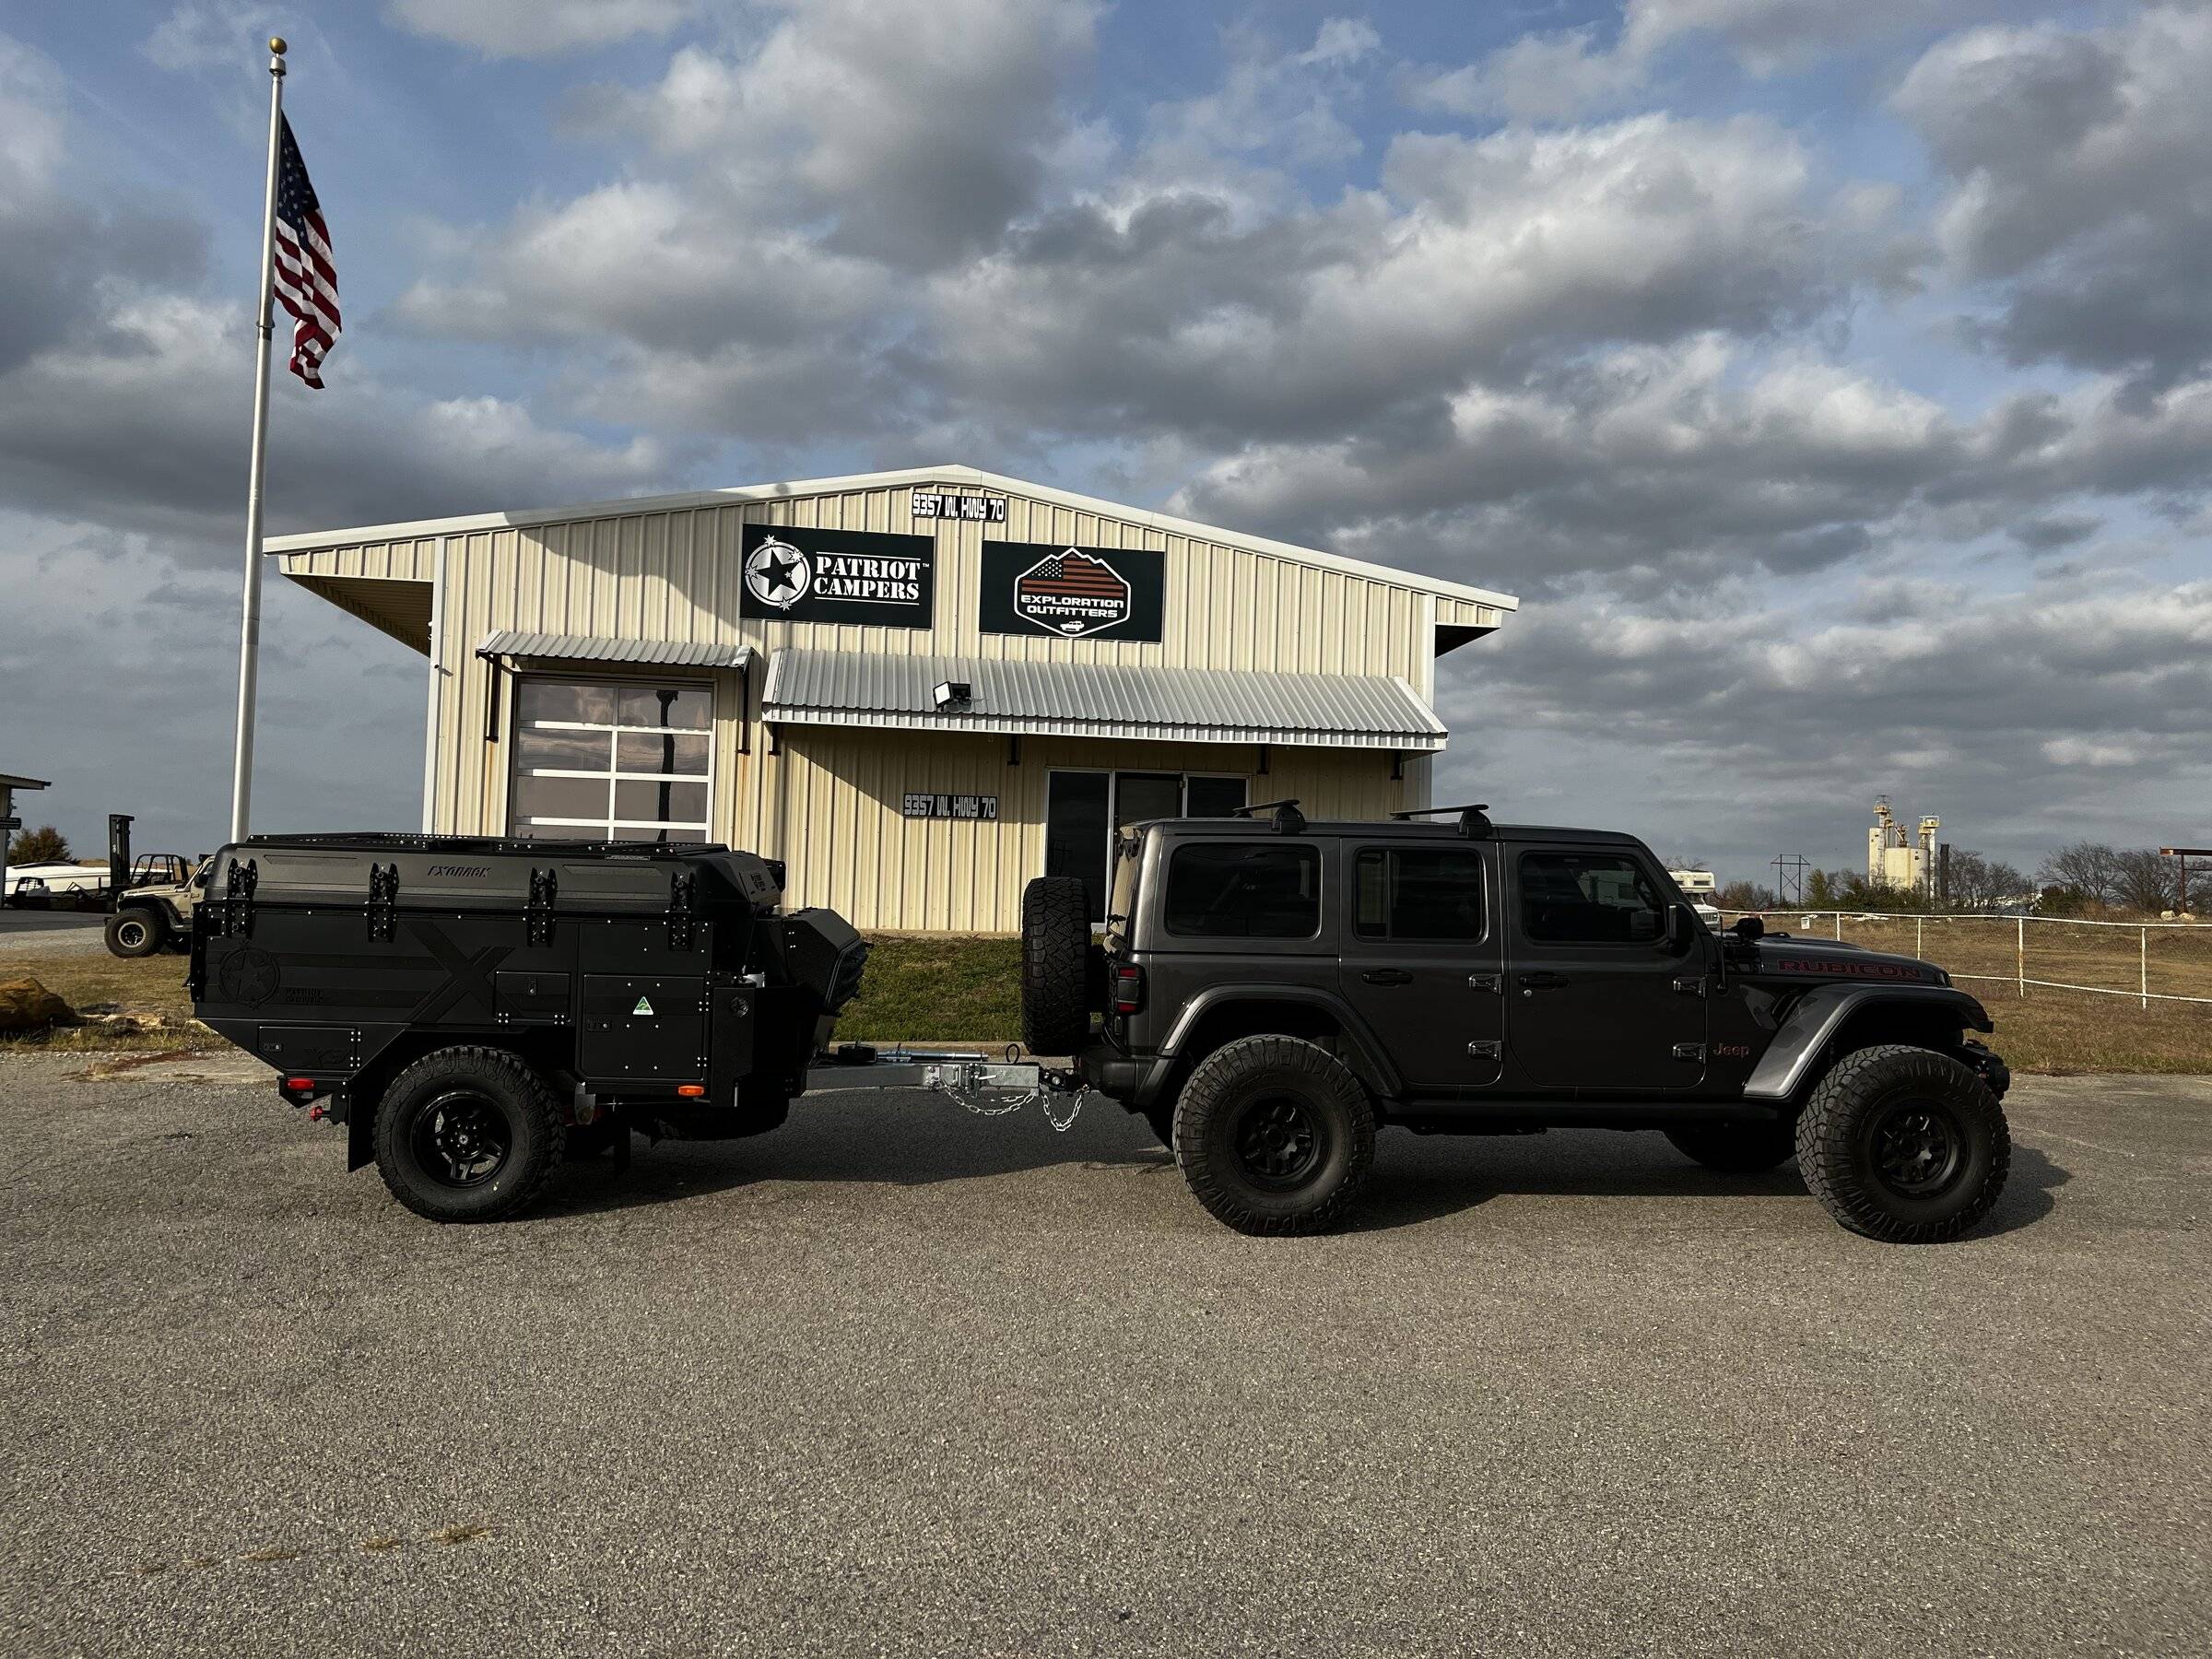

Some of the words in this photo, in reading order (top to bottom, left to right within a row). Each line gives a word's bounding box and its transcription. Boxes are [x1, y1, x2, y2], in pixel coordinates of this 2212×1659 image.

[912, 493, 942, 516] 9357
[945, 495, 959, 518] W.
[960, 497, 987, 519] HWY
[990, 499, 1005, 521] 70
[816, 556, 921, 580] PATRIOT
[813, 577, 920, 600] CAMPERS
[1020, 594, 1124, 607] EXPLORATION
[1026, 605, 1118, 618] OUTFITTERS
[904, 794, 934, 816] 9357
[936, 795, 950, 817] W.
[953, 796, 979, 818] HWY
[982, 797, 996, 818] 70
[1778, 959, 1922, 978] RUBICON
[1712, 1043, 1750, 1059] Jeep
